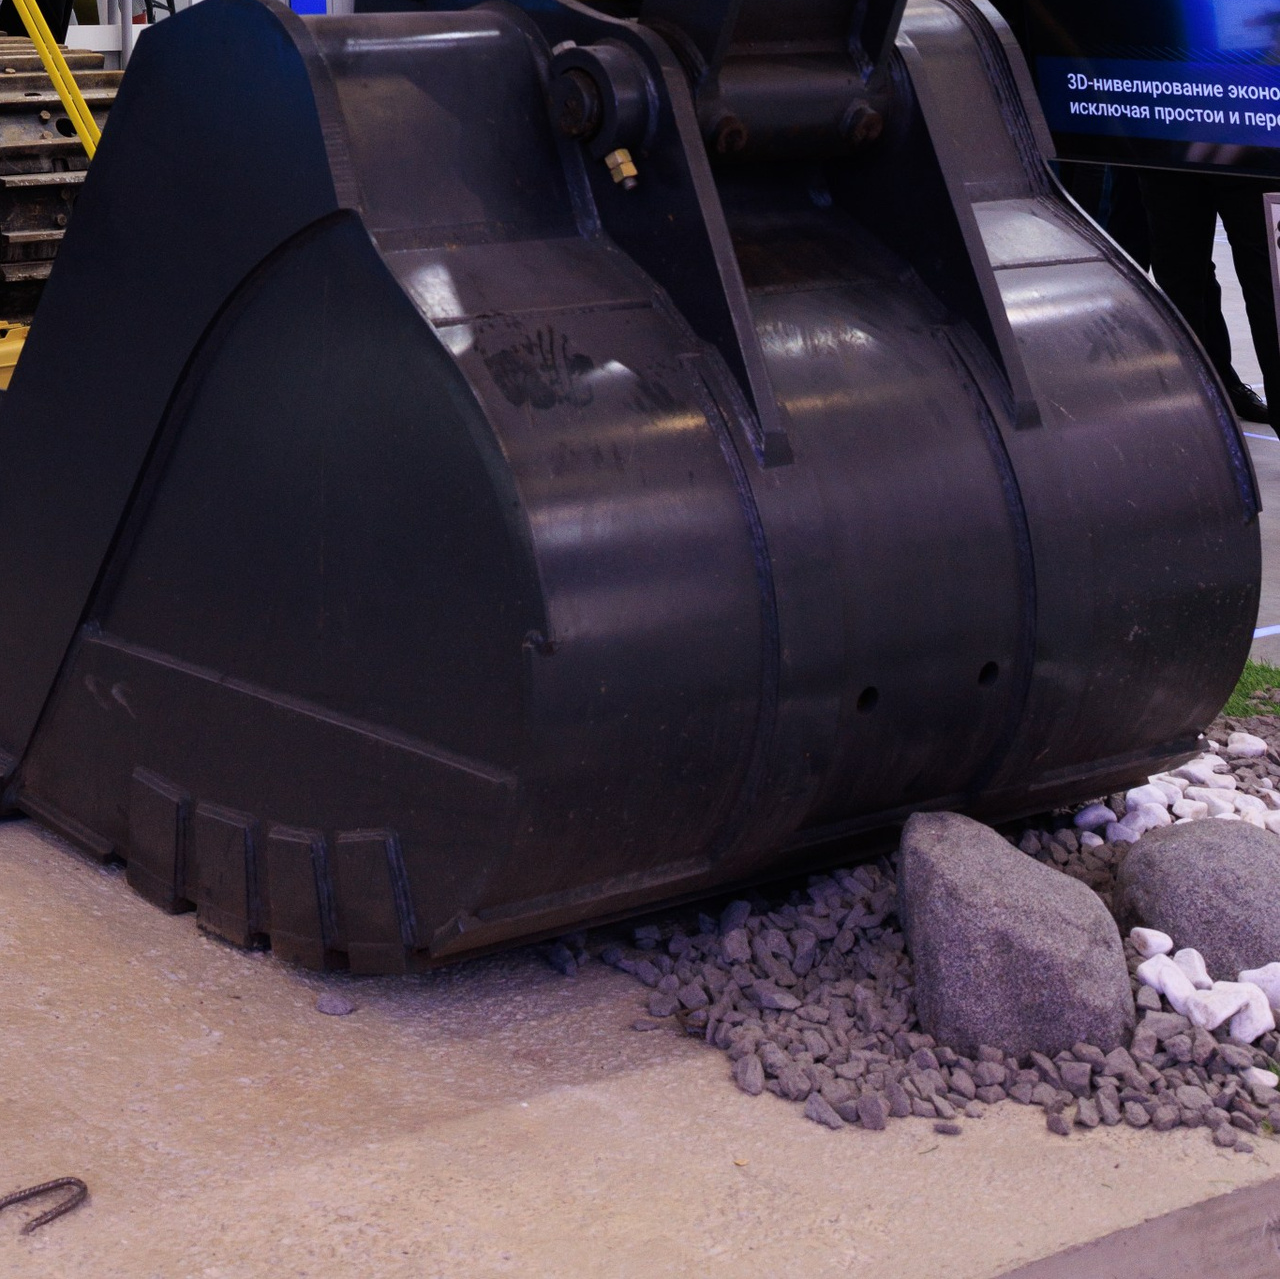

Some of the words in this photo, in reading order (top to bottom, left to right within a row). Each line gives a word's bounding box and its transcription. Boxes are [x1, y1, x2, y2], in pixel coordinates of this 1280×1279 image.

[1067, 73, 1224, 99] 3D-нивелирование
[1069, 101, 1150, 119] исключая
[1154, 106, 1225, 125] простои
[1229, 110, 1240, 125] и
